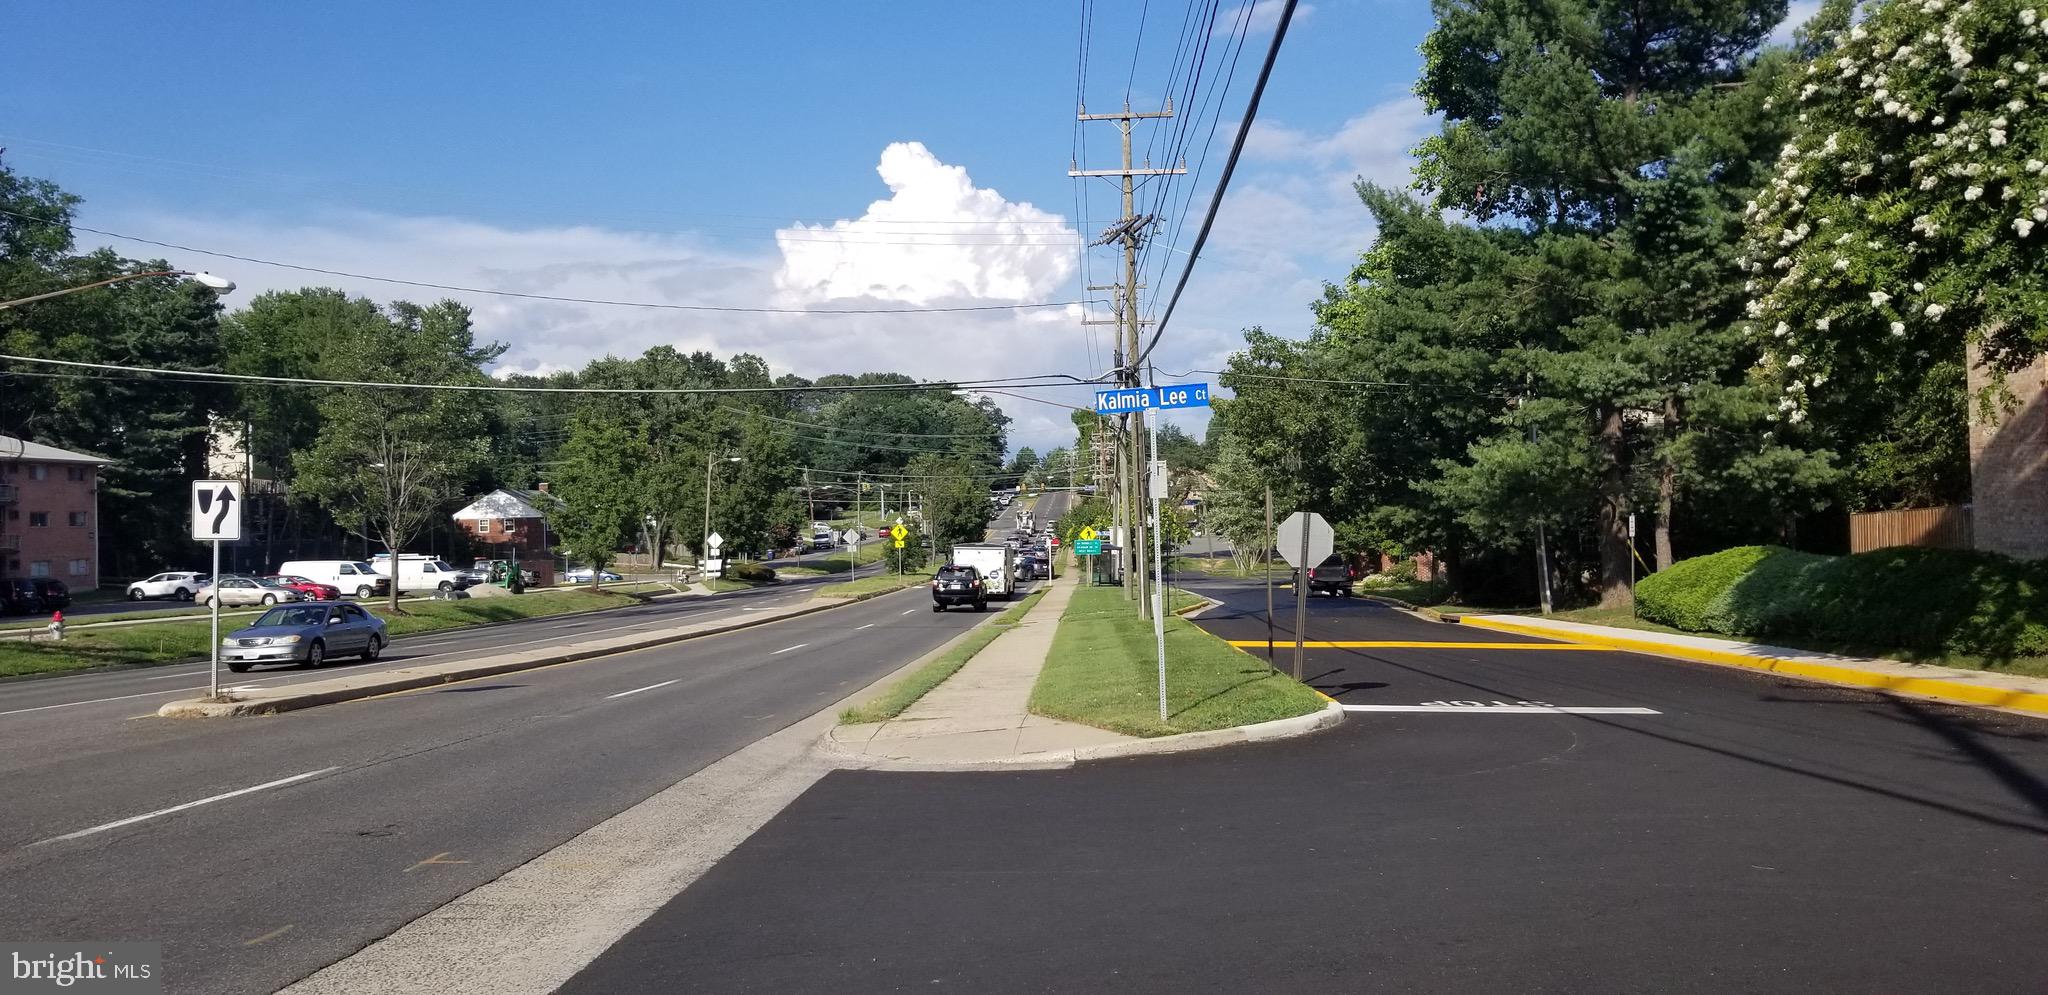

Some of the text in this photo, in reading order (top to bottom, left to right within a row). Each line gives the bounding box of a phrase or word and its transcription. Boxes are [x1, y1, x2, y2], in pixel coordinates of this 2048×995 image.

[1098, 389, 1206, 410] Kalmia Lee Ct
